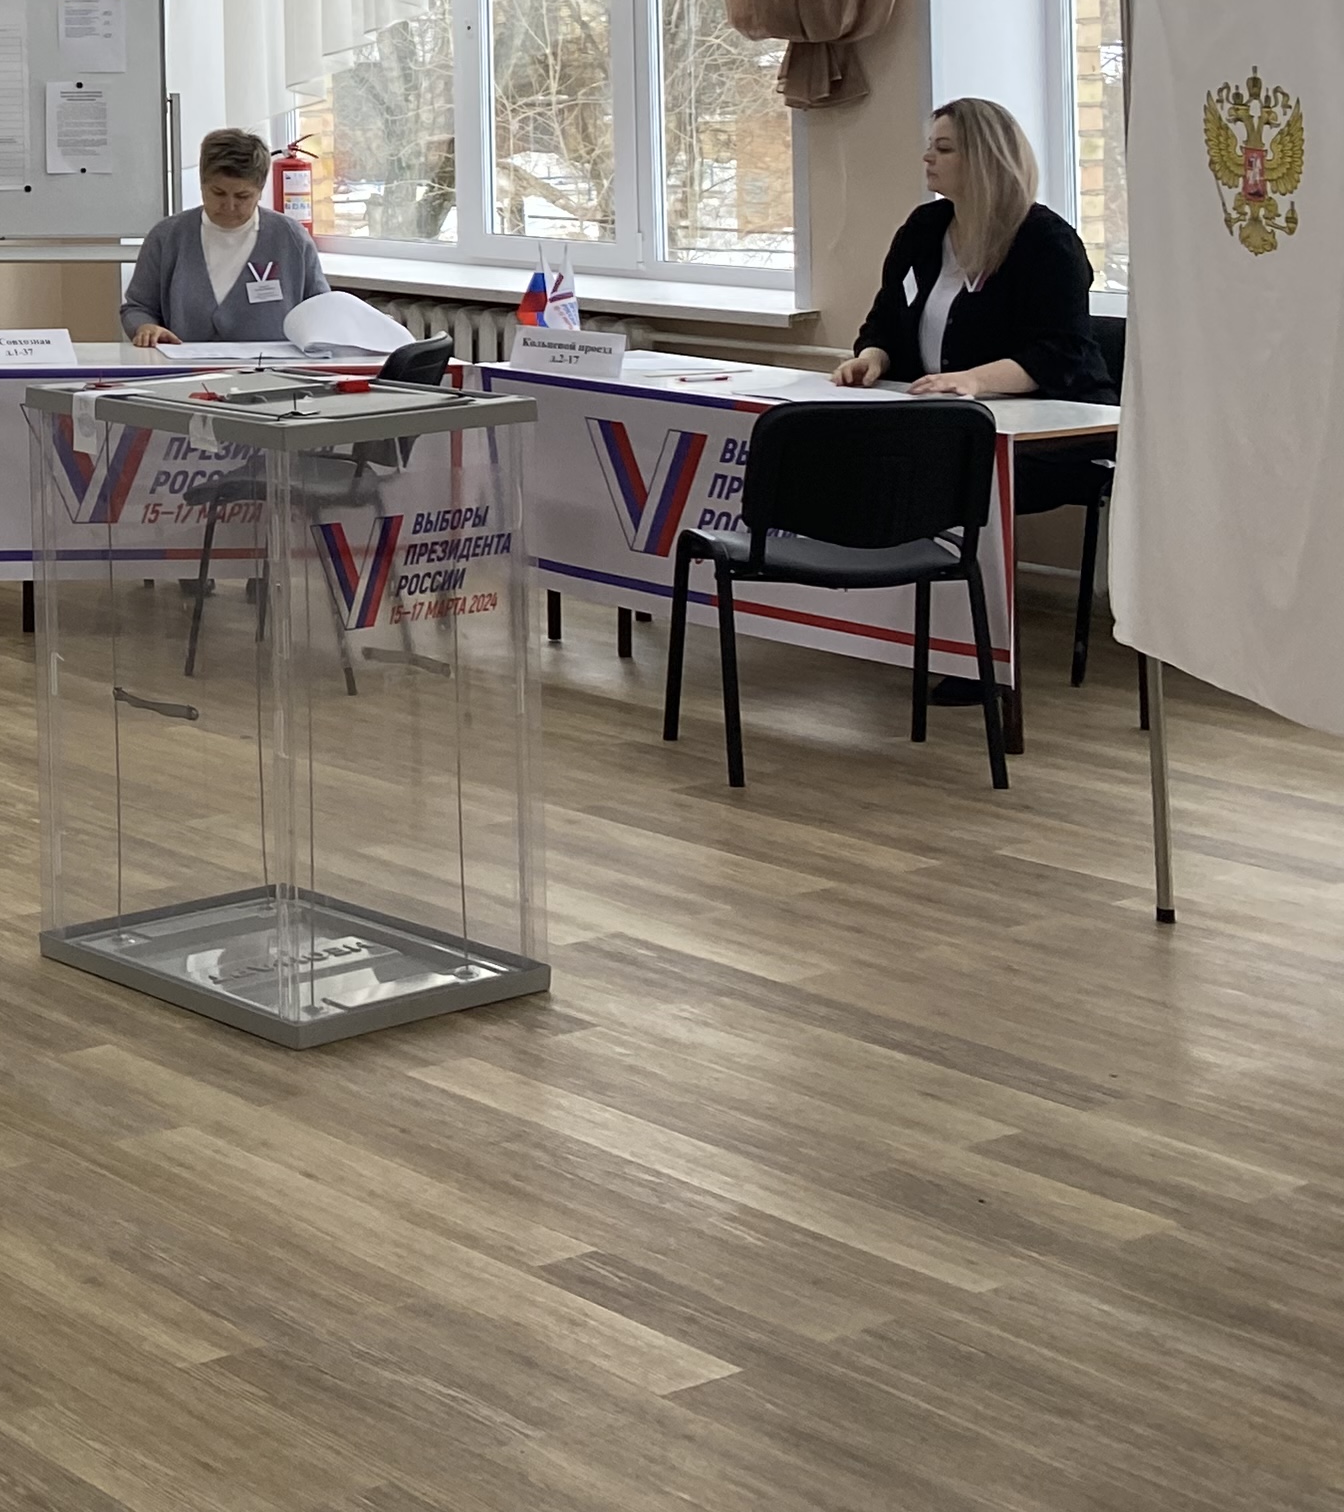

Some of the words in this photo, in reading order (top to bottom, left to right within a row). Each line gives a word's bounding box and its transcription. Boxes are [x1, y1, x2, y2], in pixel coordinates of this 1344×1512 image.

[412, 506, 489, 535] ВЫБОРЫ
[403, 533, 512, 566] ПРЕЗИДЕНТА
[396, 568, 466, 597] РОССИИ
[425, 596, 467, 620] МАРТА
[468, 592, 498, 614] 2024
